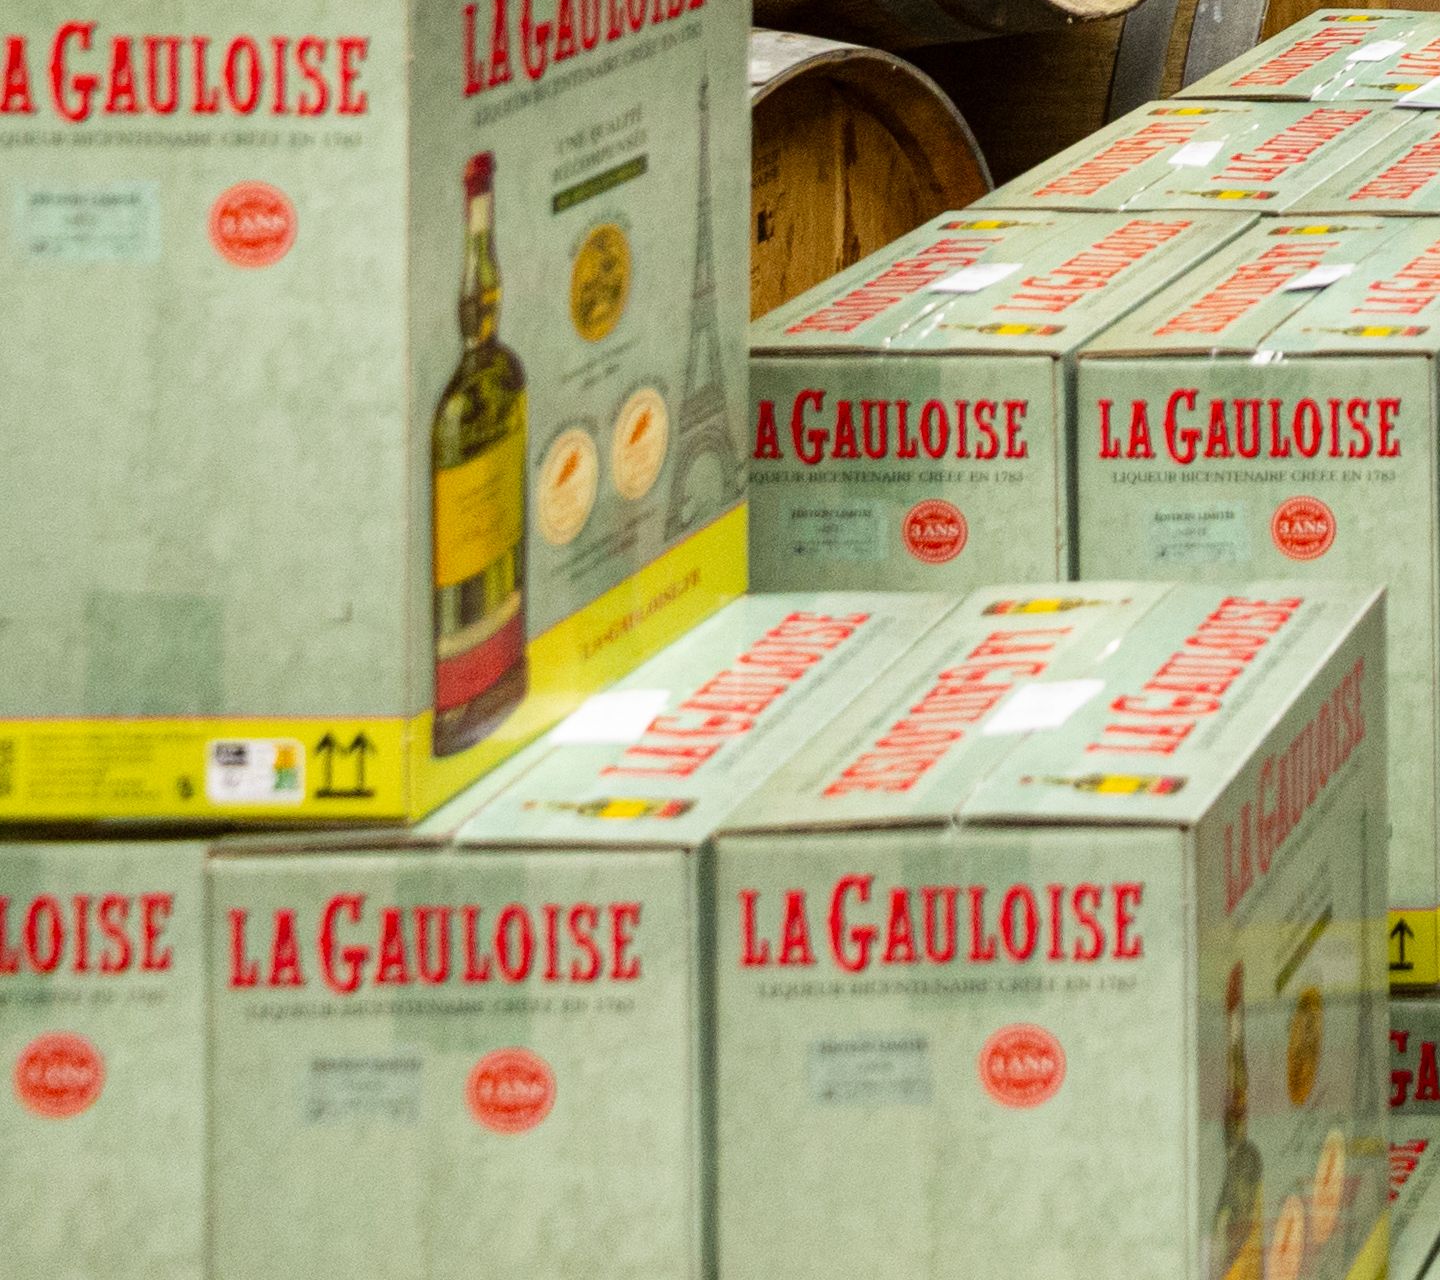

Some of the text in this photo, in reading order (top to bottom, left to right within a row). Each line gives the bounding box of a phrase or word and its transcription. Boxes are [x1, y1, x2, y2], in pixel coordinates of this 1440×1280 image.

[0, 33, 36, 116] A
[46, 19, 368, 124] GAULOISE
[753, 388, 1027, 465] A GAULOISE
[1097, 388, 1400, 466] LA GAULOISE
[1341, 470, 1362, 483] EN
[1293, 519, 1327, 535] ANS
[228, 892, 640, 996] LA GAULOISE
[738, 873, 1142, 975] LA GAULOISE
